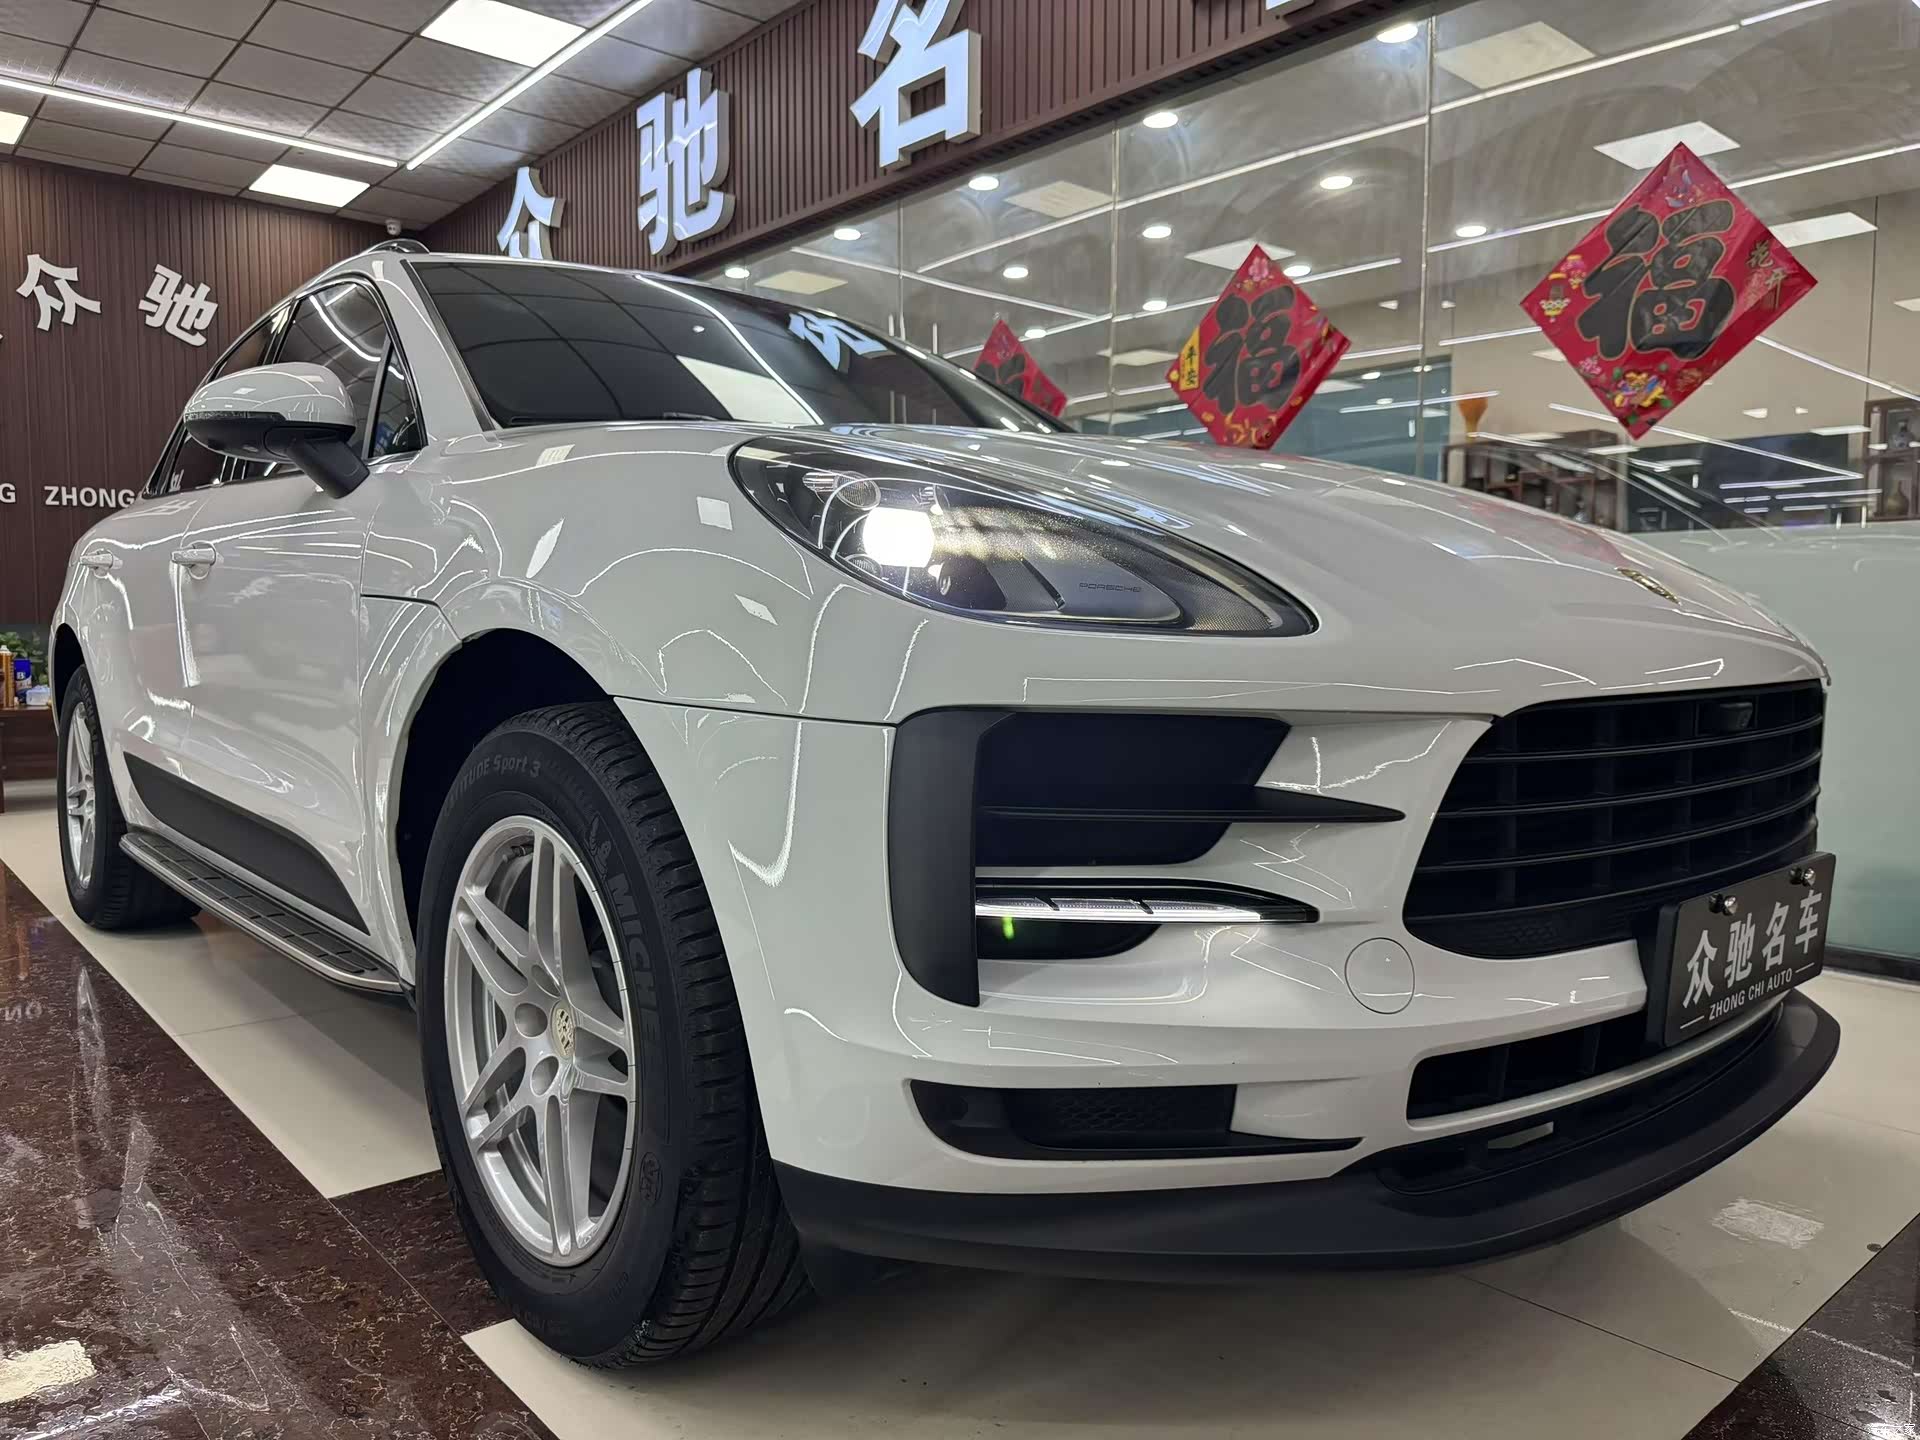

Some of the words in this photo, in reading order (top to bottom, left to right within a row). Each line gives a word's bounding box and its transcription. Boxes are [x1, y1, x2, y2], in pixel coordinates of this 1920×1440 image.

[1577, 199, 1735, 361] 福
[1203, 284, 1301, 416] 福
[44, 485, 136, 508] ZHONG
[1079, 582, 1141, 593] PORSCHE
[493, 754, 528, 776] Sport
[529, 760, 542, 779] 3
[1682, 890, 1822, 1009] 众驰名车
[1709, 991, 1745, 1021] ZHONG
[1748, 979, 1765, 1001] CHI
[1767, 968, 1793, 993] AUTO
